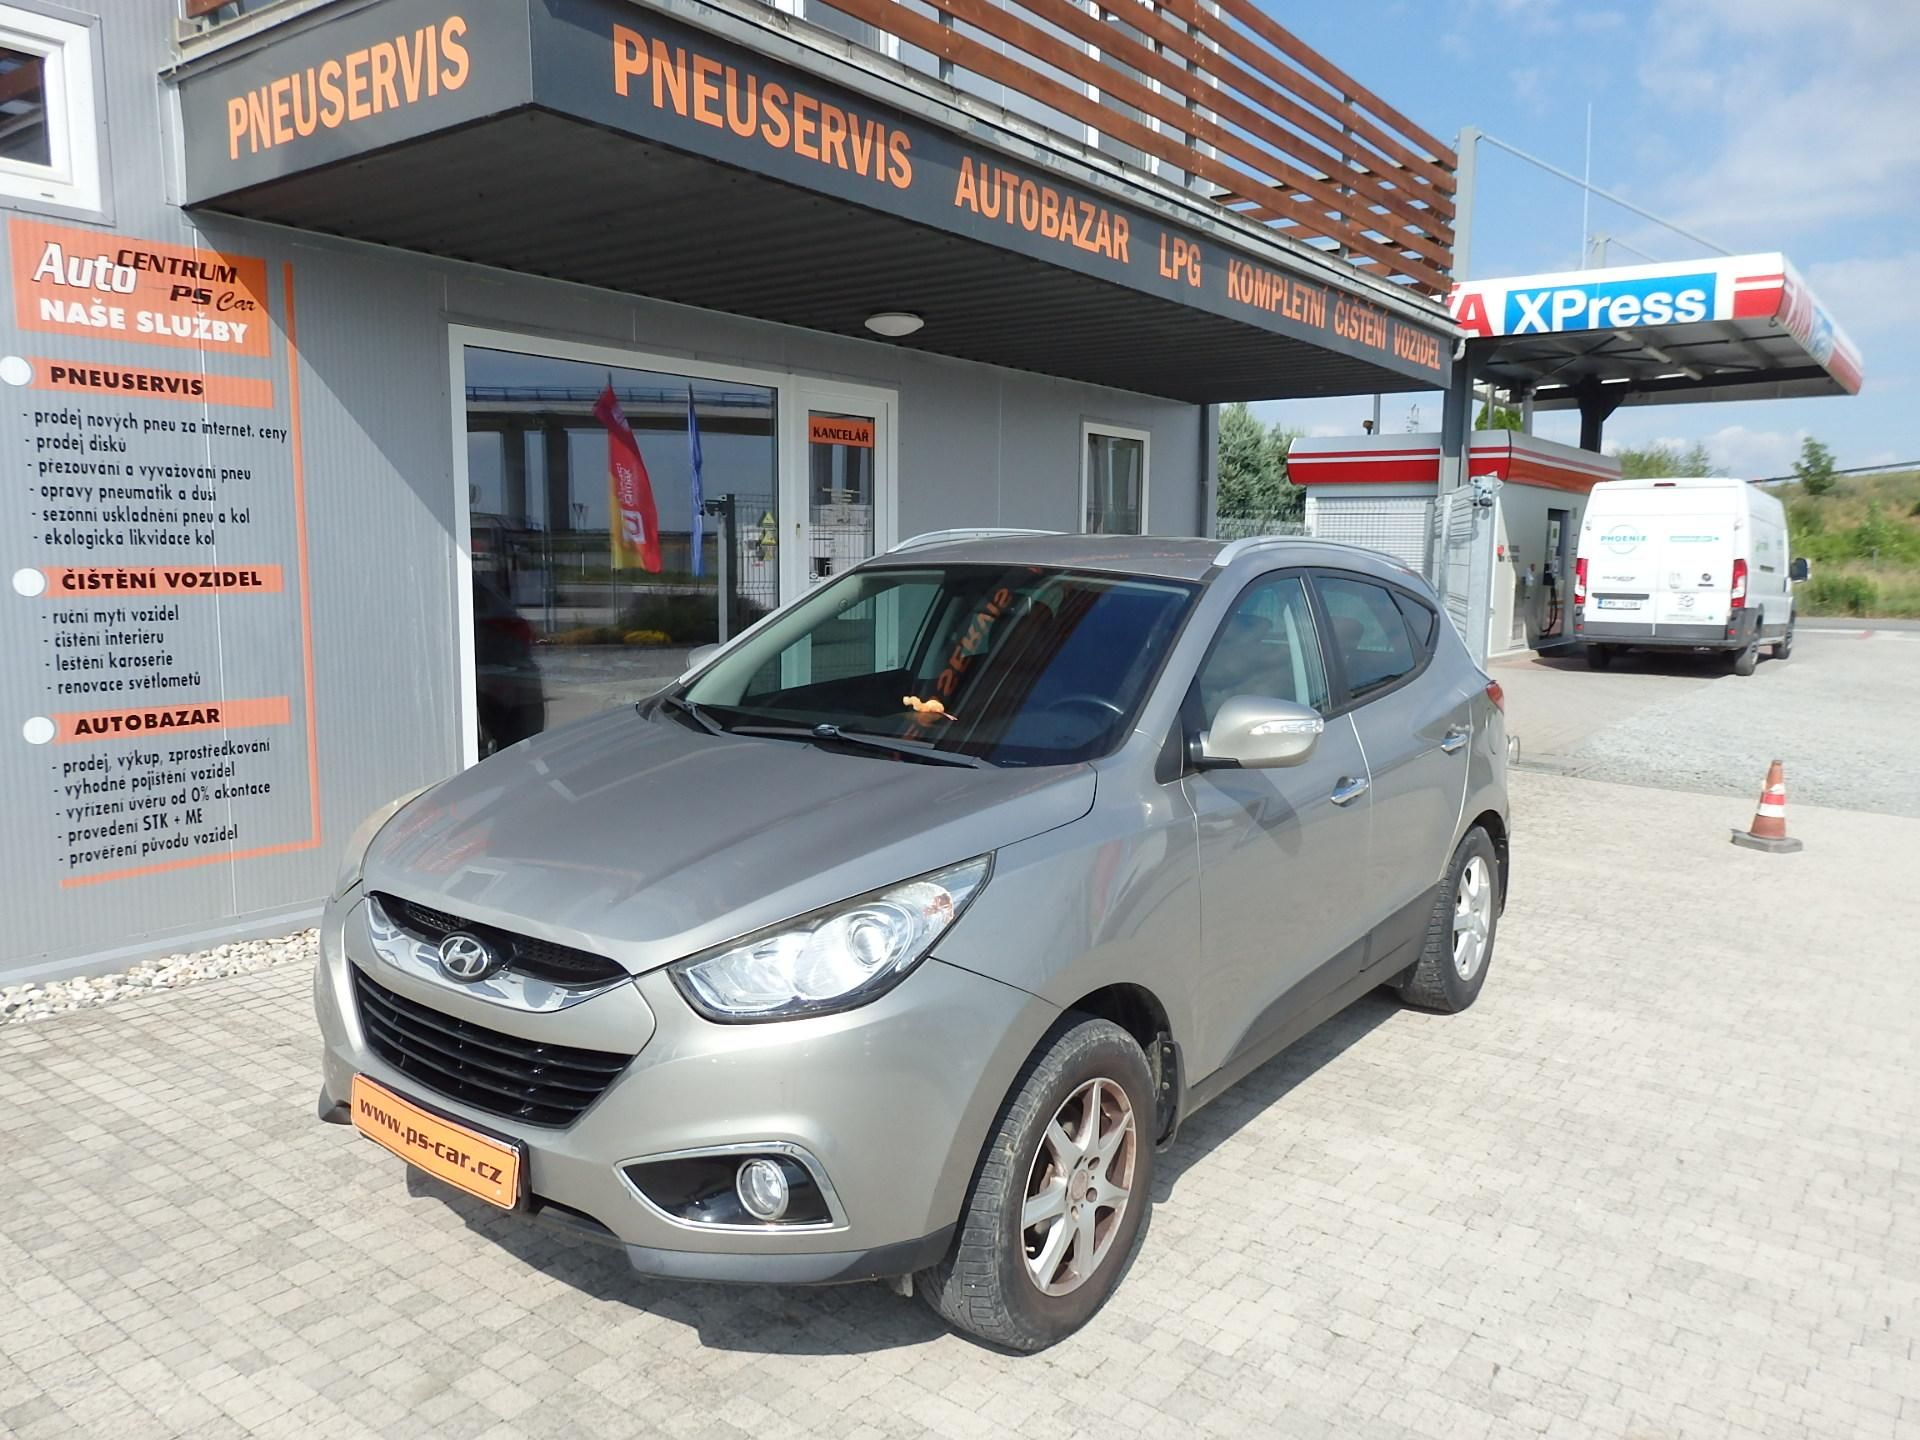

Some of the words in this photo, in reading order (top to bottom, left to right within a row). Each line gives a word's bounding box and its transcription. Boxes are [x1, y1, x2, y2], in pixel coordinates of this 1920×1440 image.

[228, 15, 470, 161] PNEUSERVIS
[613, 23, 913, 190] PNEUSERVIS
[954, 155, 1129, 264] AUTOBAZAR
[1159, 232, 1201, 288] LPG
[1227, 258, 1328, 329] KOMPLETNÍ
[1333, 290, 1389, 350] ČIŠTĚNÍ
[1393, 324, 1441, 371] VOZIDEL
[31, 240, 138, 295] Auto
[117, 249, 238, 284] CENTRUM
[170, 284, 213, 306] PS
[216, 291, 256, 312] Car
[1511, 287, 1707, 335] XPress
[39, 298, 127, 330] NAŠE
[136, 311, 249, 344] SLUŽBY
[50, 366, 204, 396] PNEUSERVIS
[34, 408, 82, 430] prodej
[87, 412, 138, 432] nových
[144, 416, 177, 434] pneu
[181, 420, 197, 434] za
[202, 418, 255, 438] internet.
[259, 426, 288, 443] ceny
[812, 423, 870, 443] KANCELÁŘ
[36, 434, 84, 454] prodej
[89, 434, 127, 453] disků
[39, 457, 121, 477] přezouvání
[125, 465, 134, 476] a
[139, 462, 217, 481] vyvažování
[221, 467, 252, 483] pneu
[41, 486, 93, 503] opravy
[99, 484, 173, 503] pneumatik
[178, 490, 187, 501] a
[42, 505, 98, 523] sezónní
[102, 505, 178, 523] uskladnění
[182, 510, 214, 527] pneu
[218, 512, 226, 523] a
[230, 507, 251, 524] kol
[44, 528, 124, 550] ekologická
[129, 528, 191, 546] likvidace
[195, 529, 215, 546] kol
[62, 567, 157, 590] ČIŠTĚNÍ
[165, 571, 262, 588] VOZIDEL
[53, 607, 88, 624] ruční
[131, 604, 179, 622] vozidel
[55, 630, 100, 648] čištění
[104, 628, 164, 646] interiéru
[56, 653, 104, 671] leštění
[108, 649, 173, 669] karoserie
[57, 677, 124, 695] renovace
[128, 671, 201, 691] světlometů
[74, 708, 221, 736] AUTOBAZAR
[63, 752, 112, 778] prodej,
[117, 749, 164, 771] výkup,
[168, 737, 271, 762] zprostředkování
[64, 774, 126, 800] výhodné
[131, 767, 187, 791] pojištění
[190, 761, 236, 781] vozidel
[66, 797, 124, 824] vyřízení
[128, 790, 166, 810] úvěru
[171, 789, 186, 804] od
[191, 784, 210, 803] 0%
[214, 781, 271, 800] akontace
[68, 818, 139, 846] provedení
[143, 813, 169, 832] STK
[185, 807, 203, 825] ME
[69, 839, 138, 869] prověření
[141, 831, 189, 858] původu
[193, 823, 238, 845] vozidel
[359, 1098, 503, 1185] www.ps-car.cz
